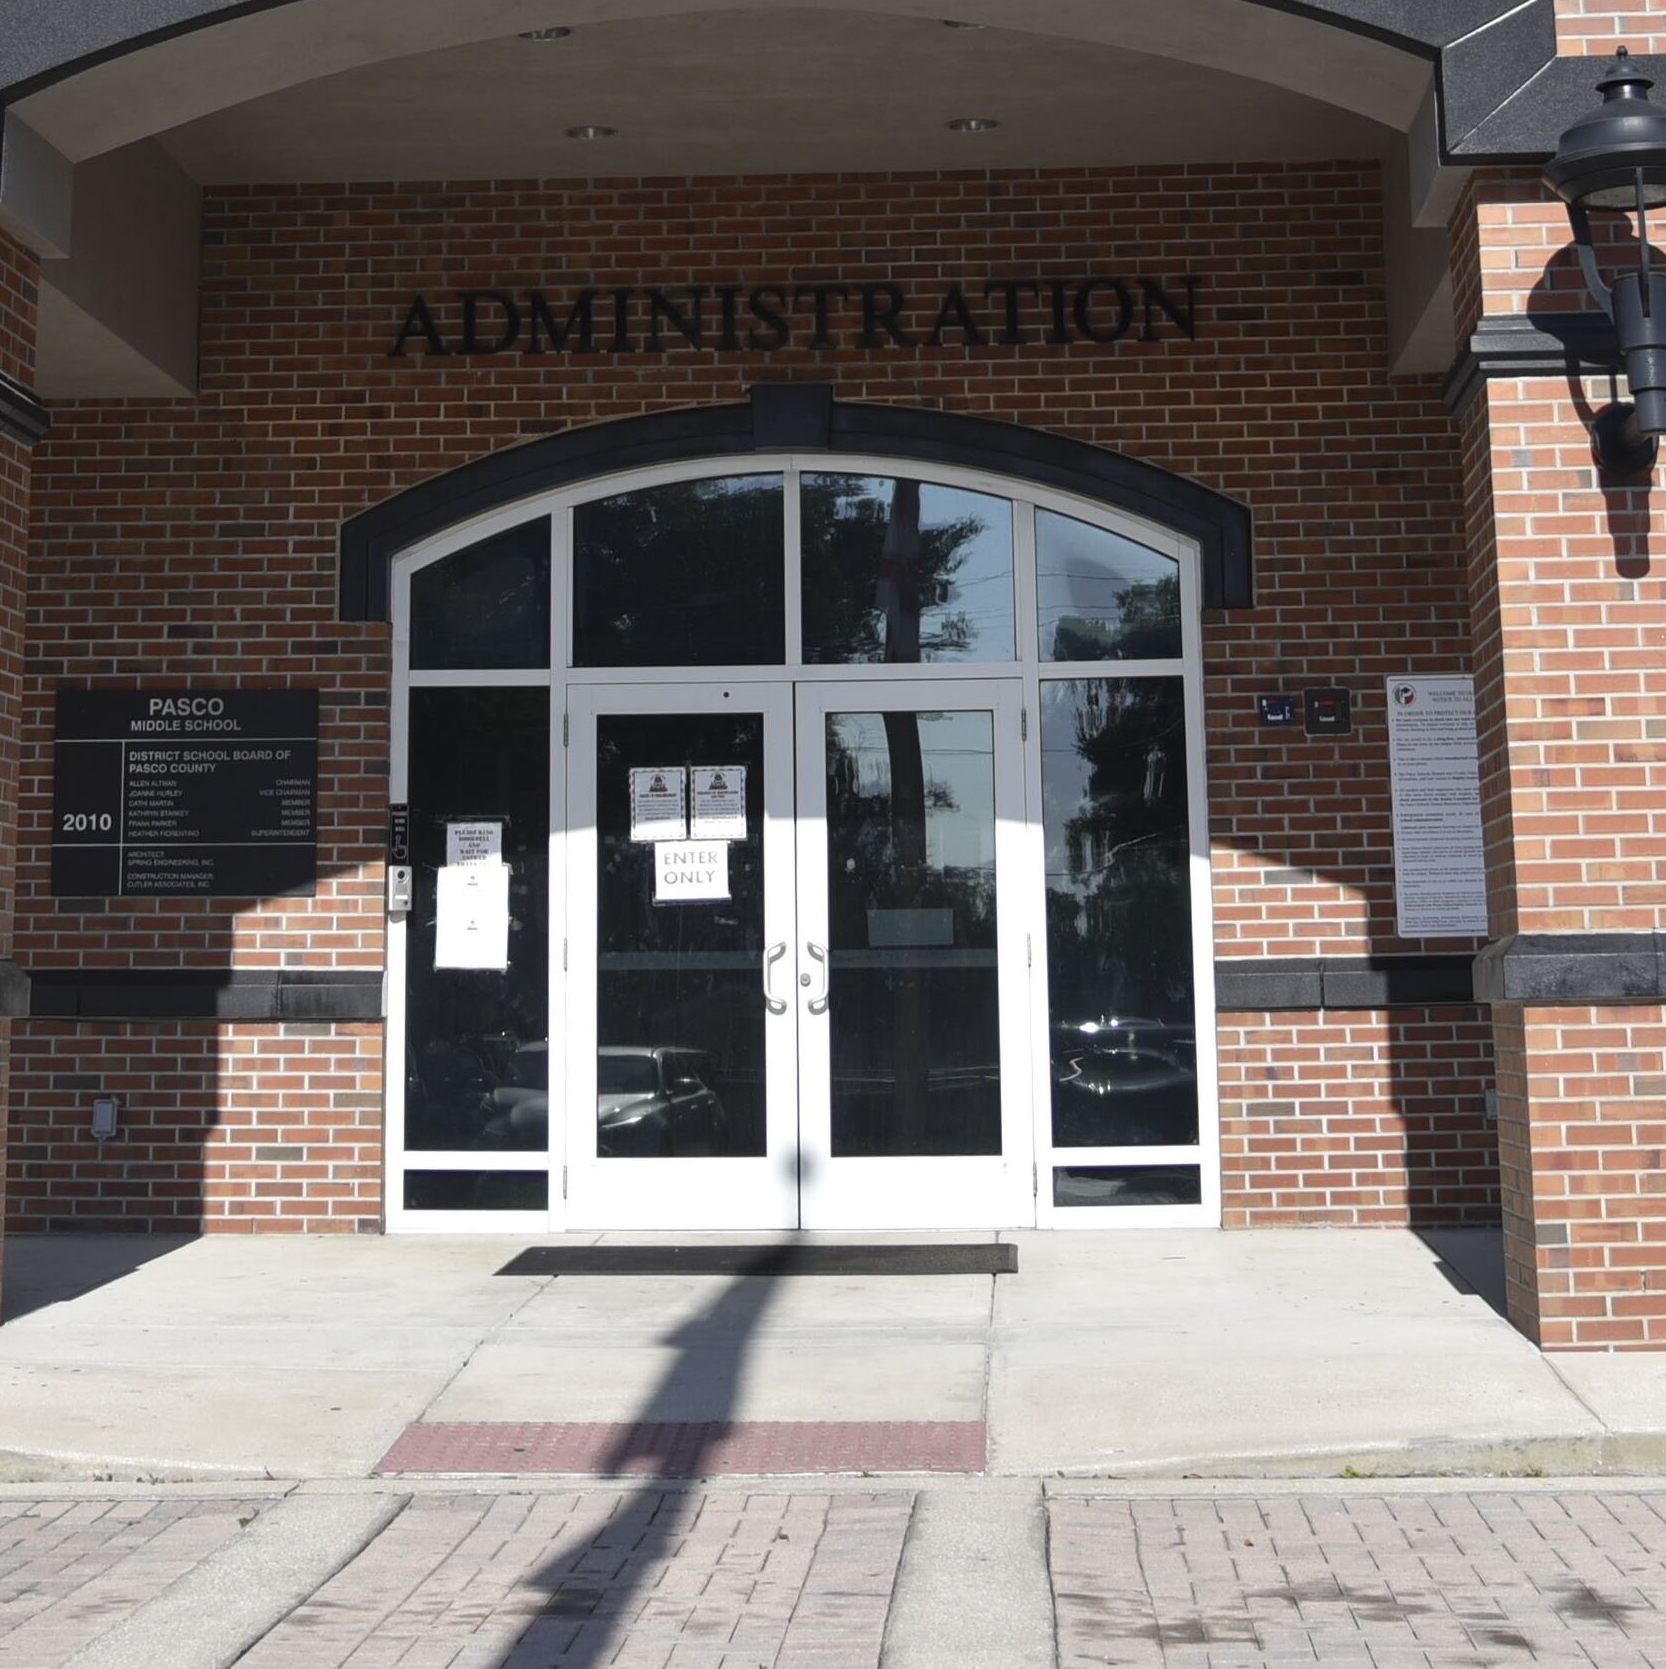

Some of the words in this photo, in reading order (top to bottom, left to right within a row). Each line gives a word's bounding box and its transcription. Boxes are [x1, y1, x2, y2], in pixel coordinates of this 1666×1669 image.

[386, 274, 1202, 357] ADMINISTRATION
[149, 698, 224, 716] PASCO
[131, 720, 181, 732] MIDDLE
[185, 719, 241, 731] SCHOOL
[129, 751, 180, 762] DISTRICT
[183, 751, 230, 761] SCHOOL
[233, 750, 273, 761] BOARD
[276, 750, 291, 760] OF
[129, 763, 167, 773] PASCO
[170, 763, 216, 773] COUNTY
[63, 814, 112, 832] 2010
[664, 851, 718, 865] ENTER
[664, 870, 715, 884] ONLY
